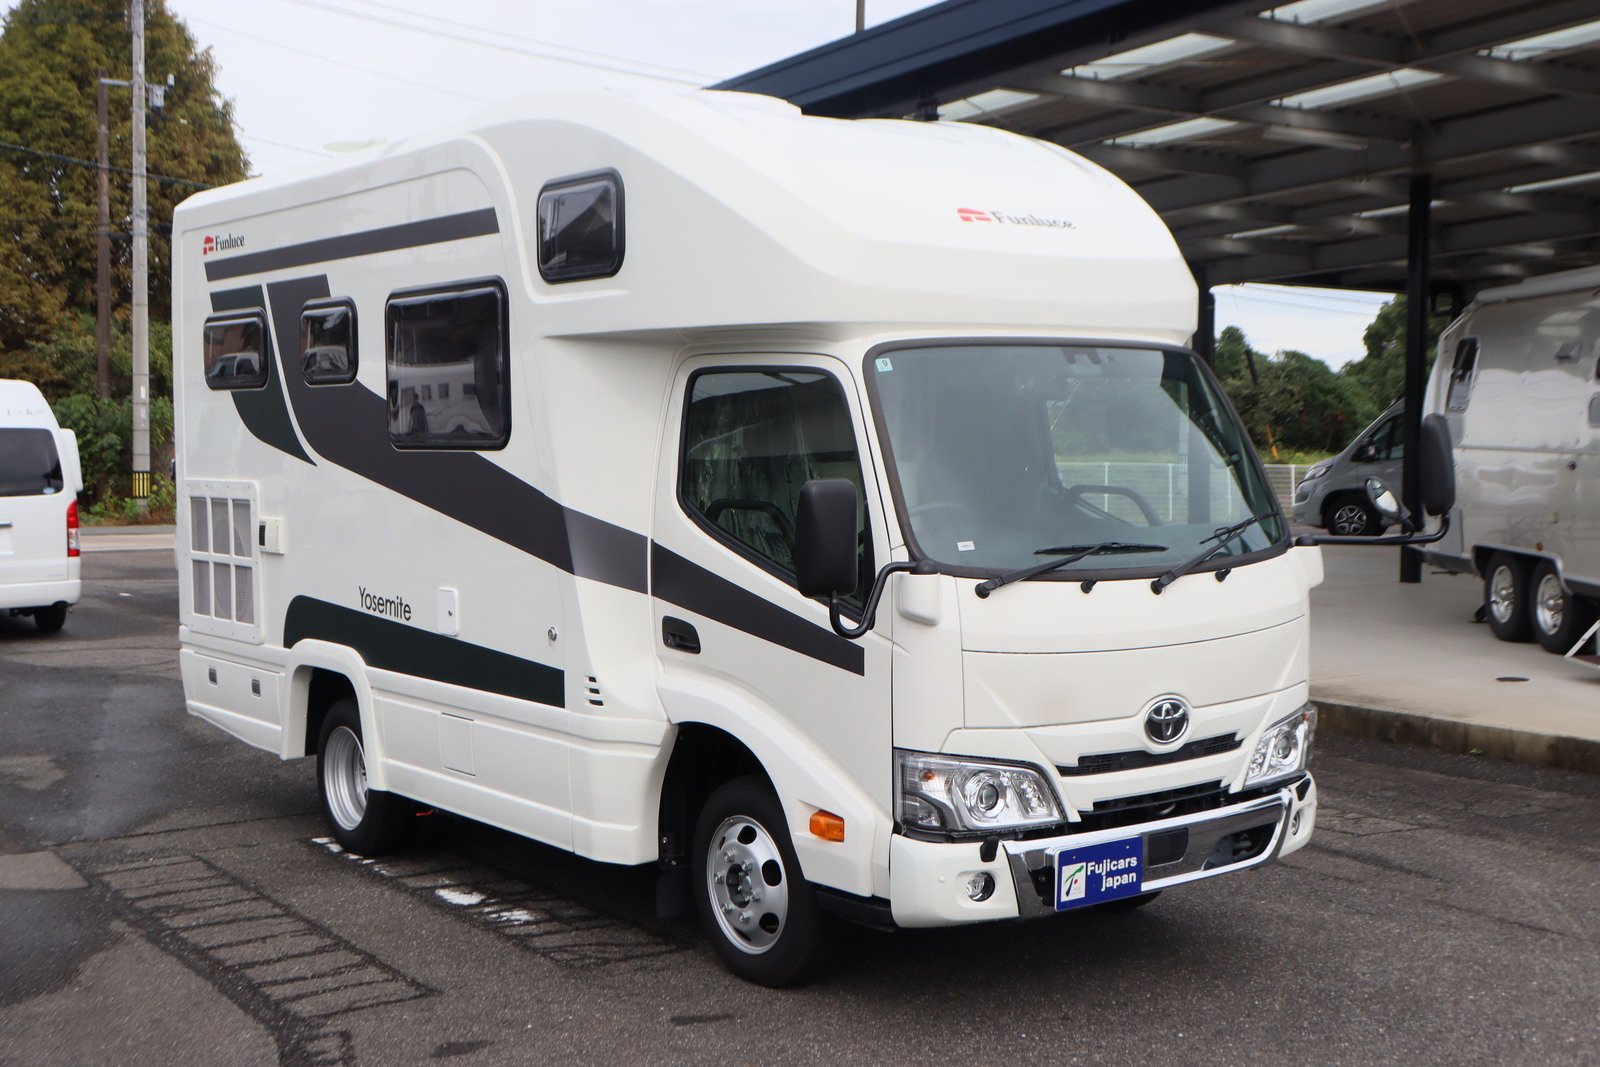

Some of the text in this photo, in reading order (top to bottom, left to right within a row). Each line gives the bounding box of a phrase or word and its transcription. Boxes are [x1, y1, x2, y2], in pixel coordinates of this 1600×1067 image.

[989, 210, 1077, 229] Funluce
[215, 232, 245, 251] Funluce
[358, 585, 412, 621] Yosemite
[1087, 856, 1138, 876] Fujicars
[1100, 872, 1137, 892] japan
